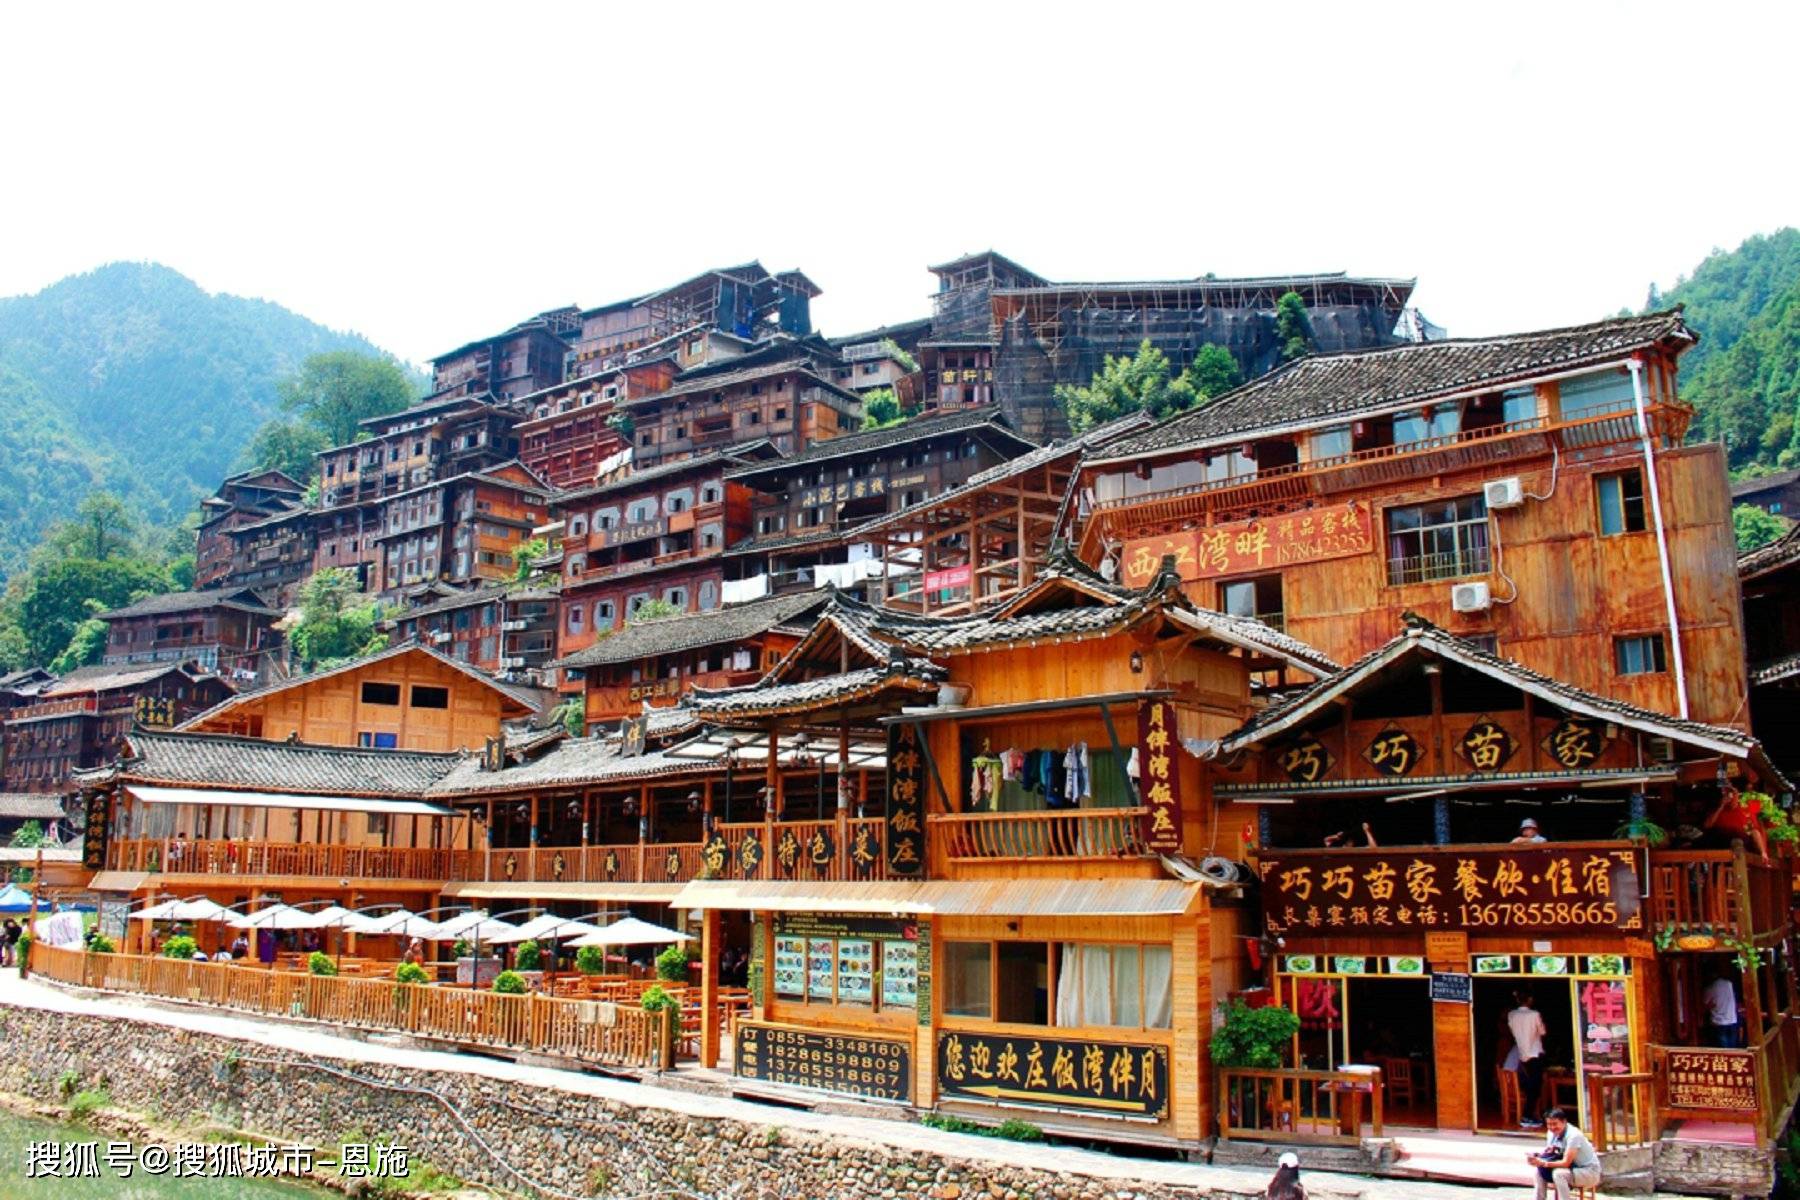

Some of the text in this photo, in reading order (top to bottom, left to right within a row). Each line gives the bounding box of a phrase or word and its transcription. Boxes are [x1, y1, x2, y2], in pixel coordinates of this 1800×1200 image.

[1277, 510, 1361, 541] 精品客栈
[1127, 522, 1272, 579] 西江湾畔
[1146, 703, 1175, 832] 月伴湾饭庄
[1286, 722, 1595, 781] 巧巧苗家
[705, 829, 874, 870] 苗家特色菜
[766, 1044, 901, 1073] 18286598809
[766, 1057, 901, 1087] 13765518667
[1672, 1054, 1749, 1073] 巧巧苗家
